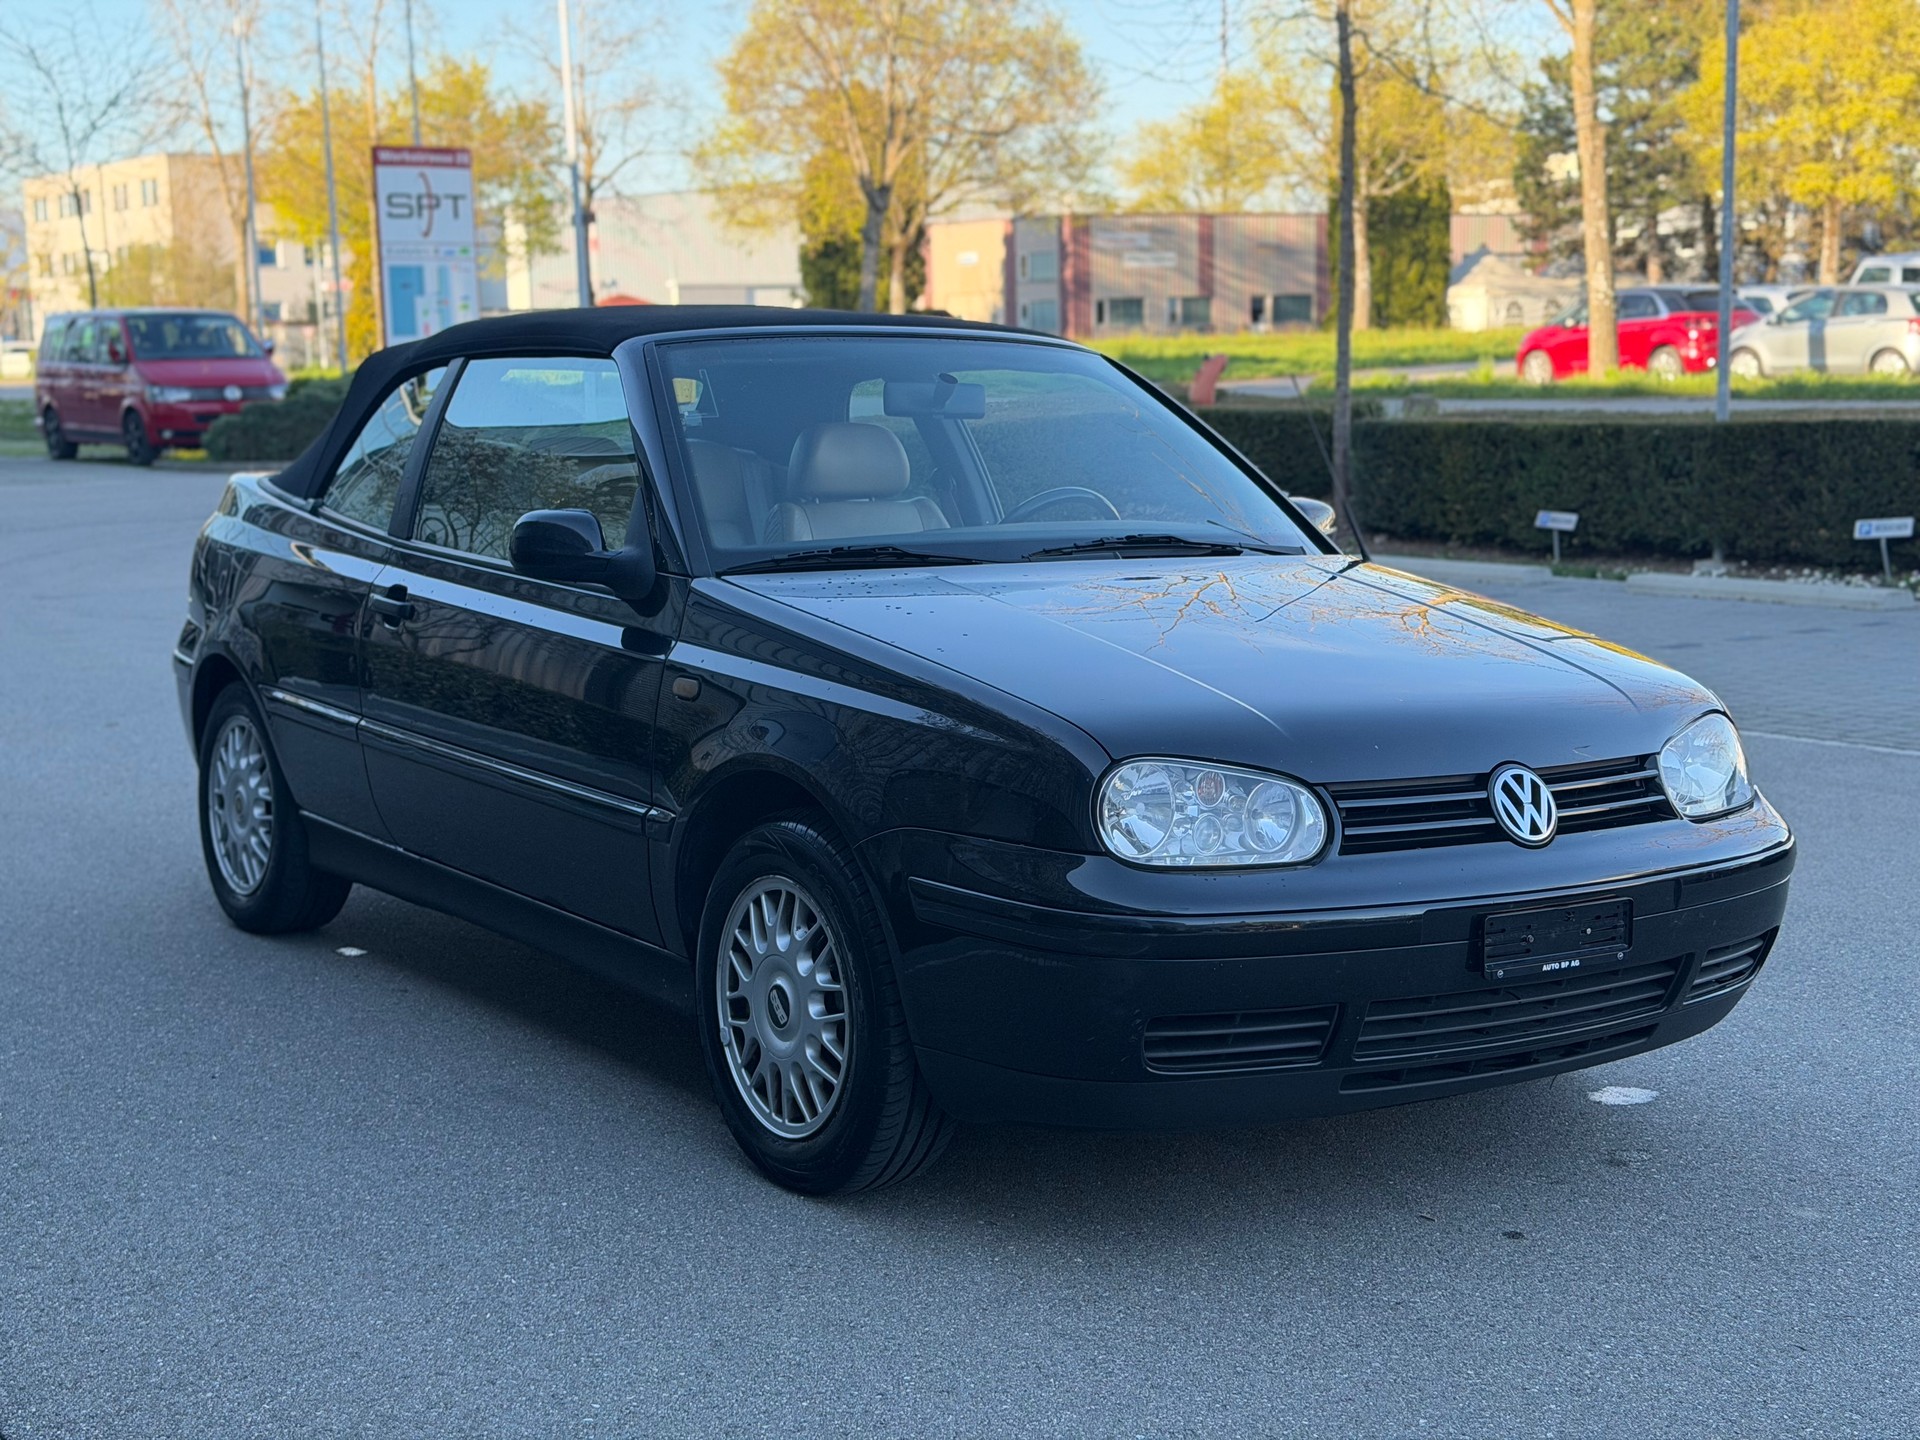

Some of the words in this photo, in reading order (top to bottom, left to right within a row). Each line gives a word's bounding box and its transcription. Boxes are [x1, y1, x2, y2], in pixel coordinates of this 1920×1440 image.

[385, 192, 467, 220] SPT
[1494, 768, 1556, 841] VW
[1542, 962, 1560, 972] AUTO
[1561, 961, 1570, 969] BP
[1571, 959, 1580, 967] AG
